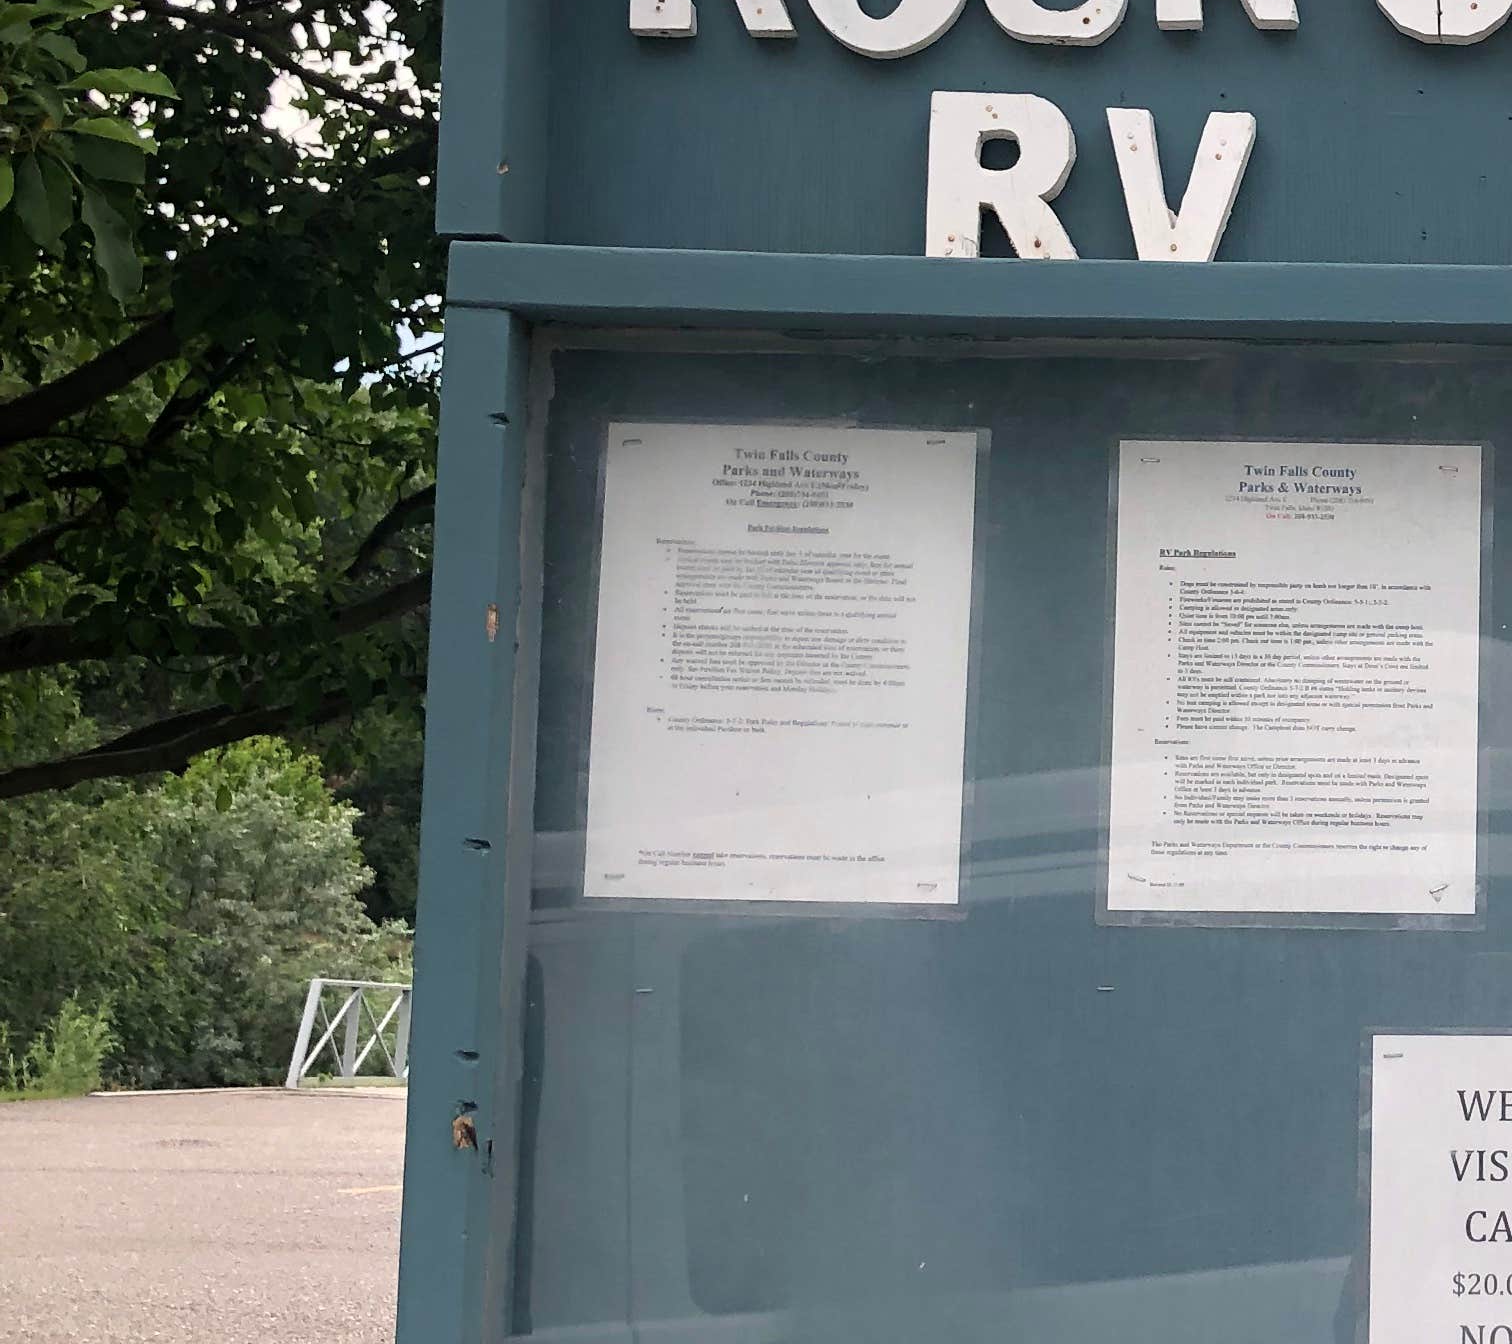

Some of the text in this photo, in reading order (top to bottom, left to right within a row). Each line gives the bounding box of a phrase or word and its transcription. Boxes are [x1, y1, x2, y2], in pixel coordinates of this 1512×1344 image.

[926, 91, 1256, 262] RV
[734, 448, 849, 464] Twin Falls County
[723, 464, 860, 481] Parks and Waterways
[1244, 465, 1356, 480] Twin Falls County
[1239, 482, 1362, 495] Parks & Waterways
